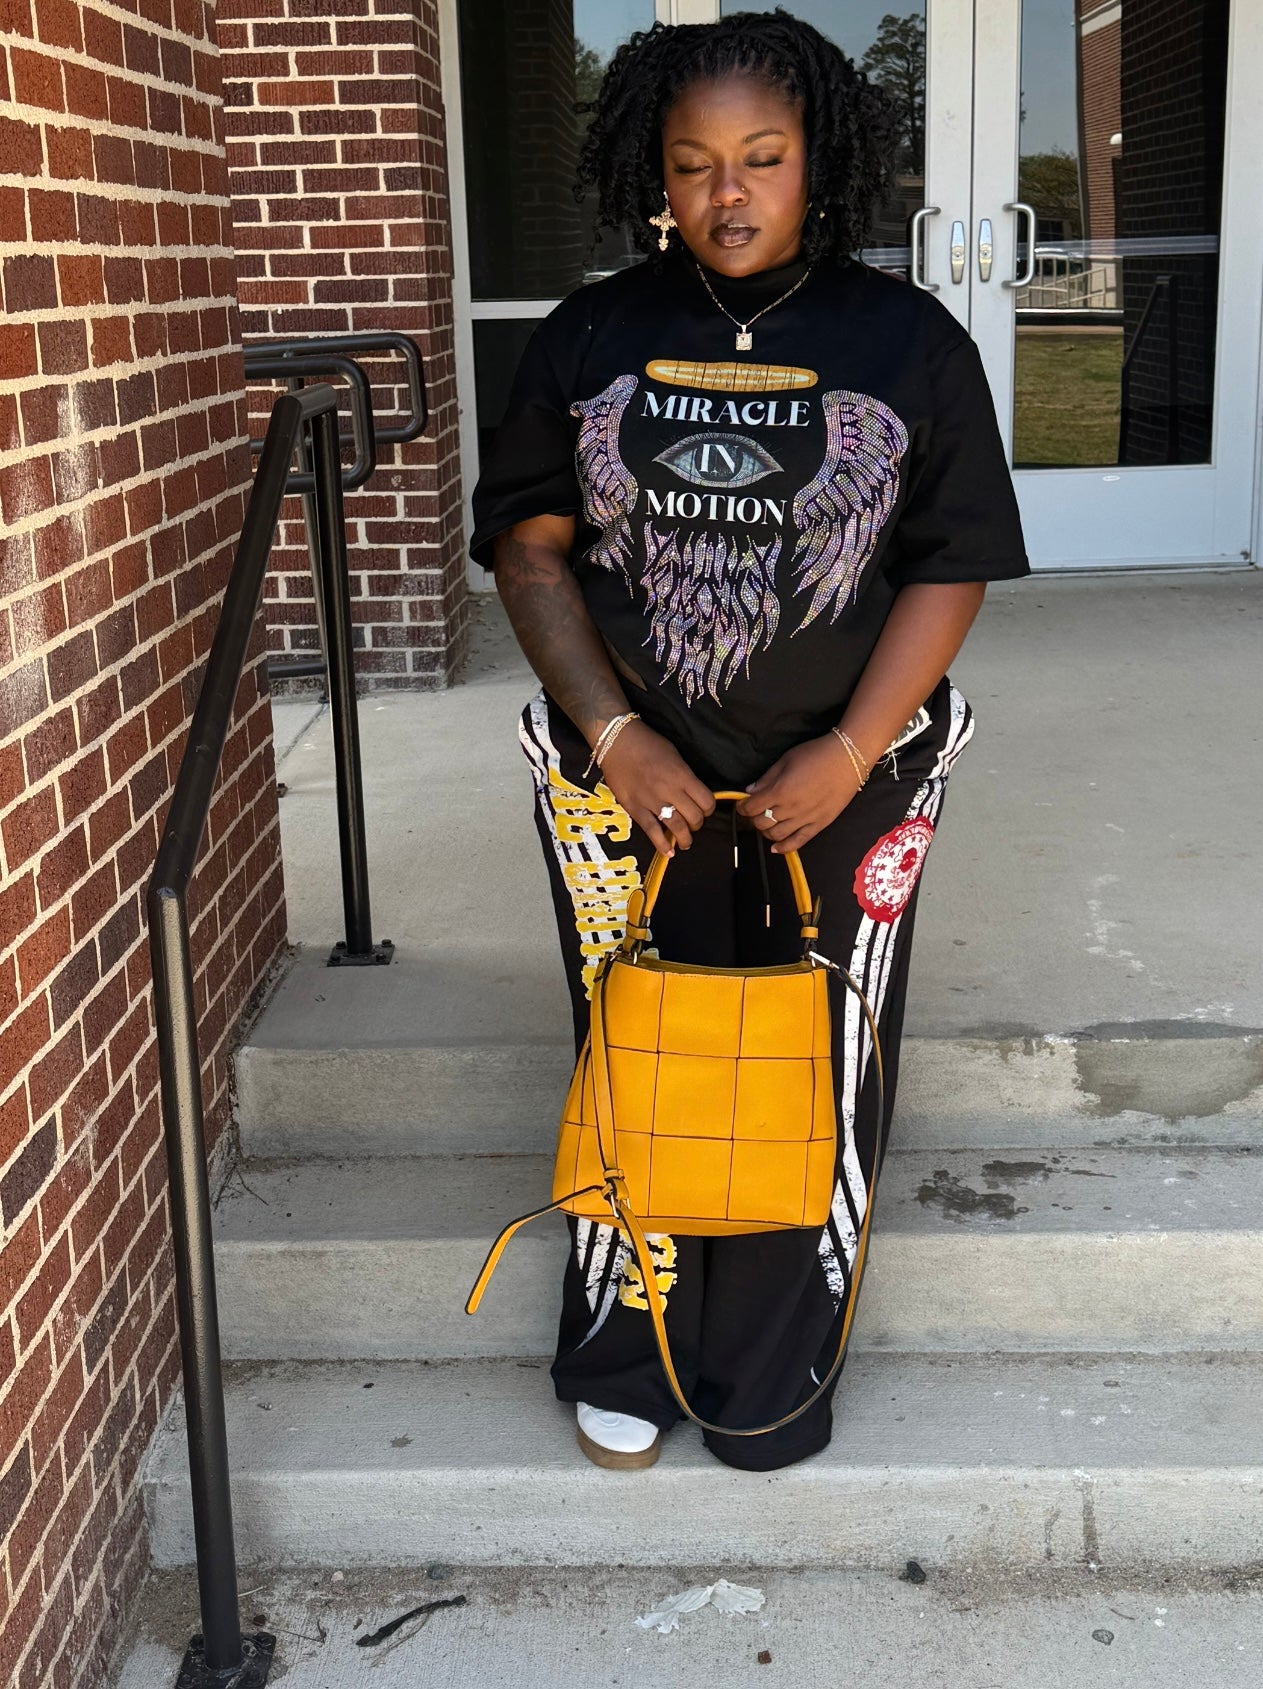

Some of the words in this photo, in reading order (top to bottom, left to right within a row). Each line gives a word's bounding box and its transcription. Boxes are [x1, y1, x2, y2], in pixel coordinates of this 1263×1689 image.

[641, 391, 810, 426] MIRACLE
[699, 443, 740, 473] IN
[645, 489, 788, 526] MOTION
